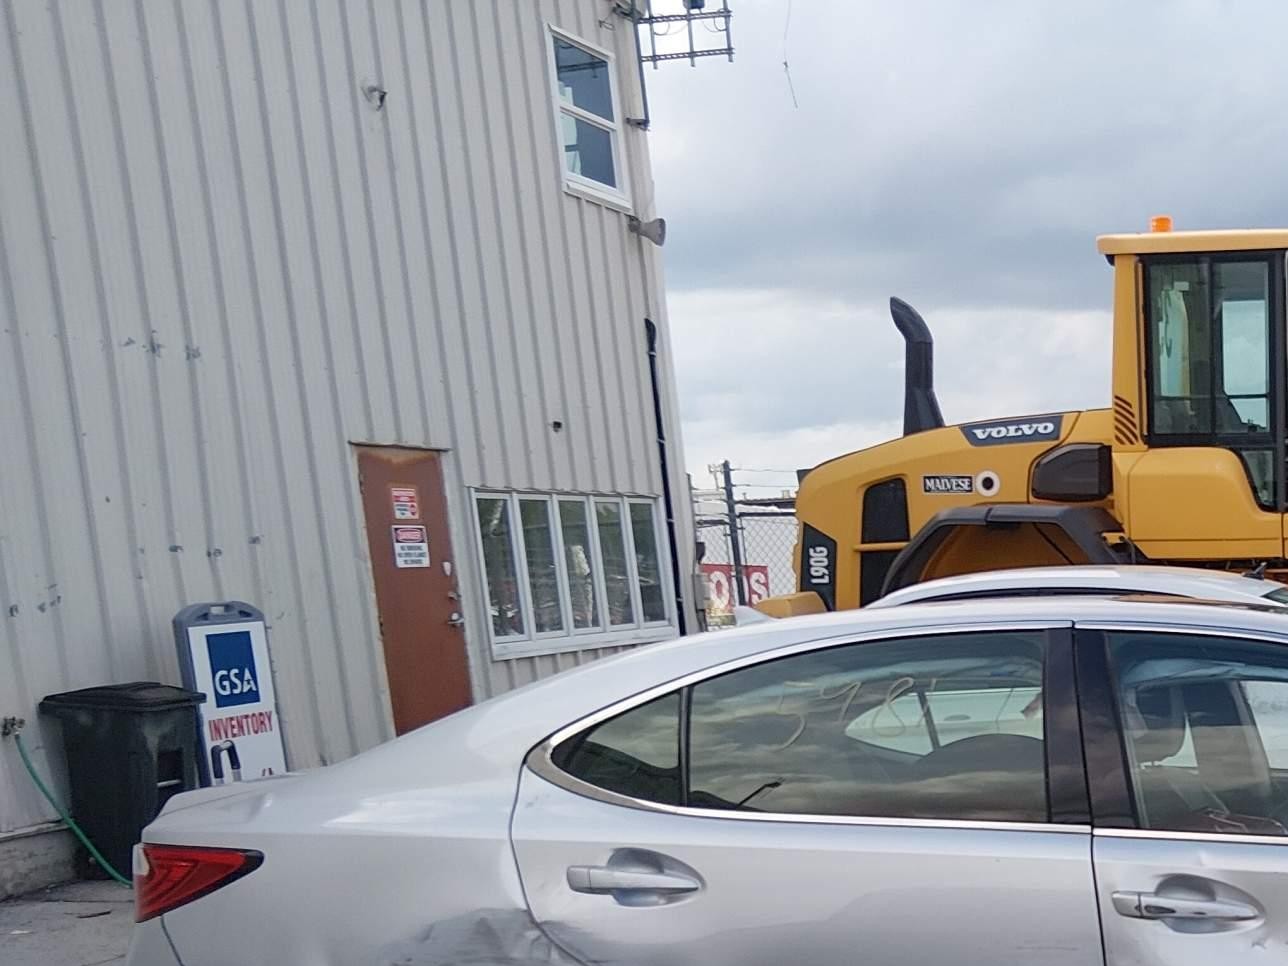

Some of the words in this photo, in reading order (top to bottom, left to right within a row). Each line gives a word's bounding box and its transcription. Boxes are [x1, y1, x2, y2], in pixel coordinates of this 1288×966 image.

[972, 422, 1054, 440] VOLVO
[808, 546, 830, 584] L90G
[214, 667, 257, 695] GSA
[208, 711, 273, 741] INVENTORY
